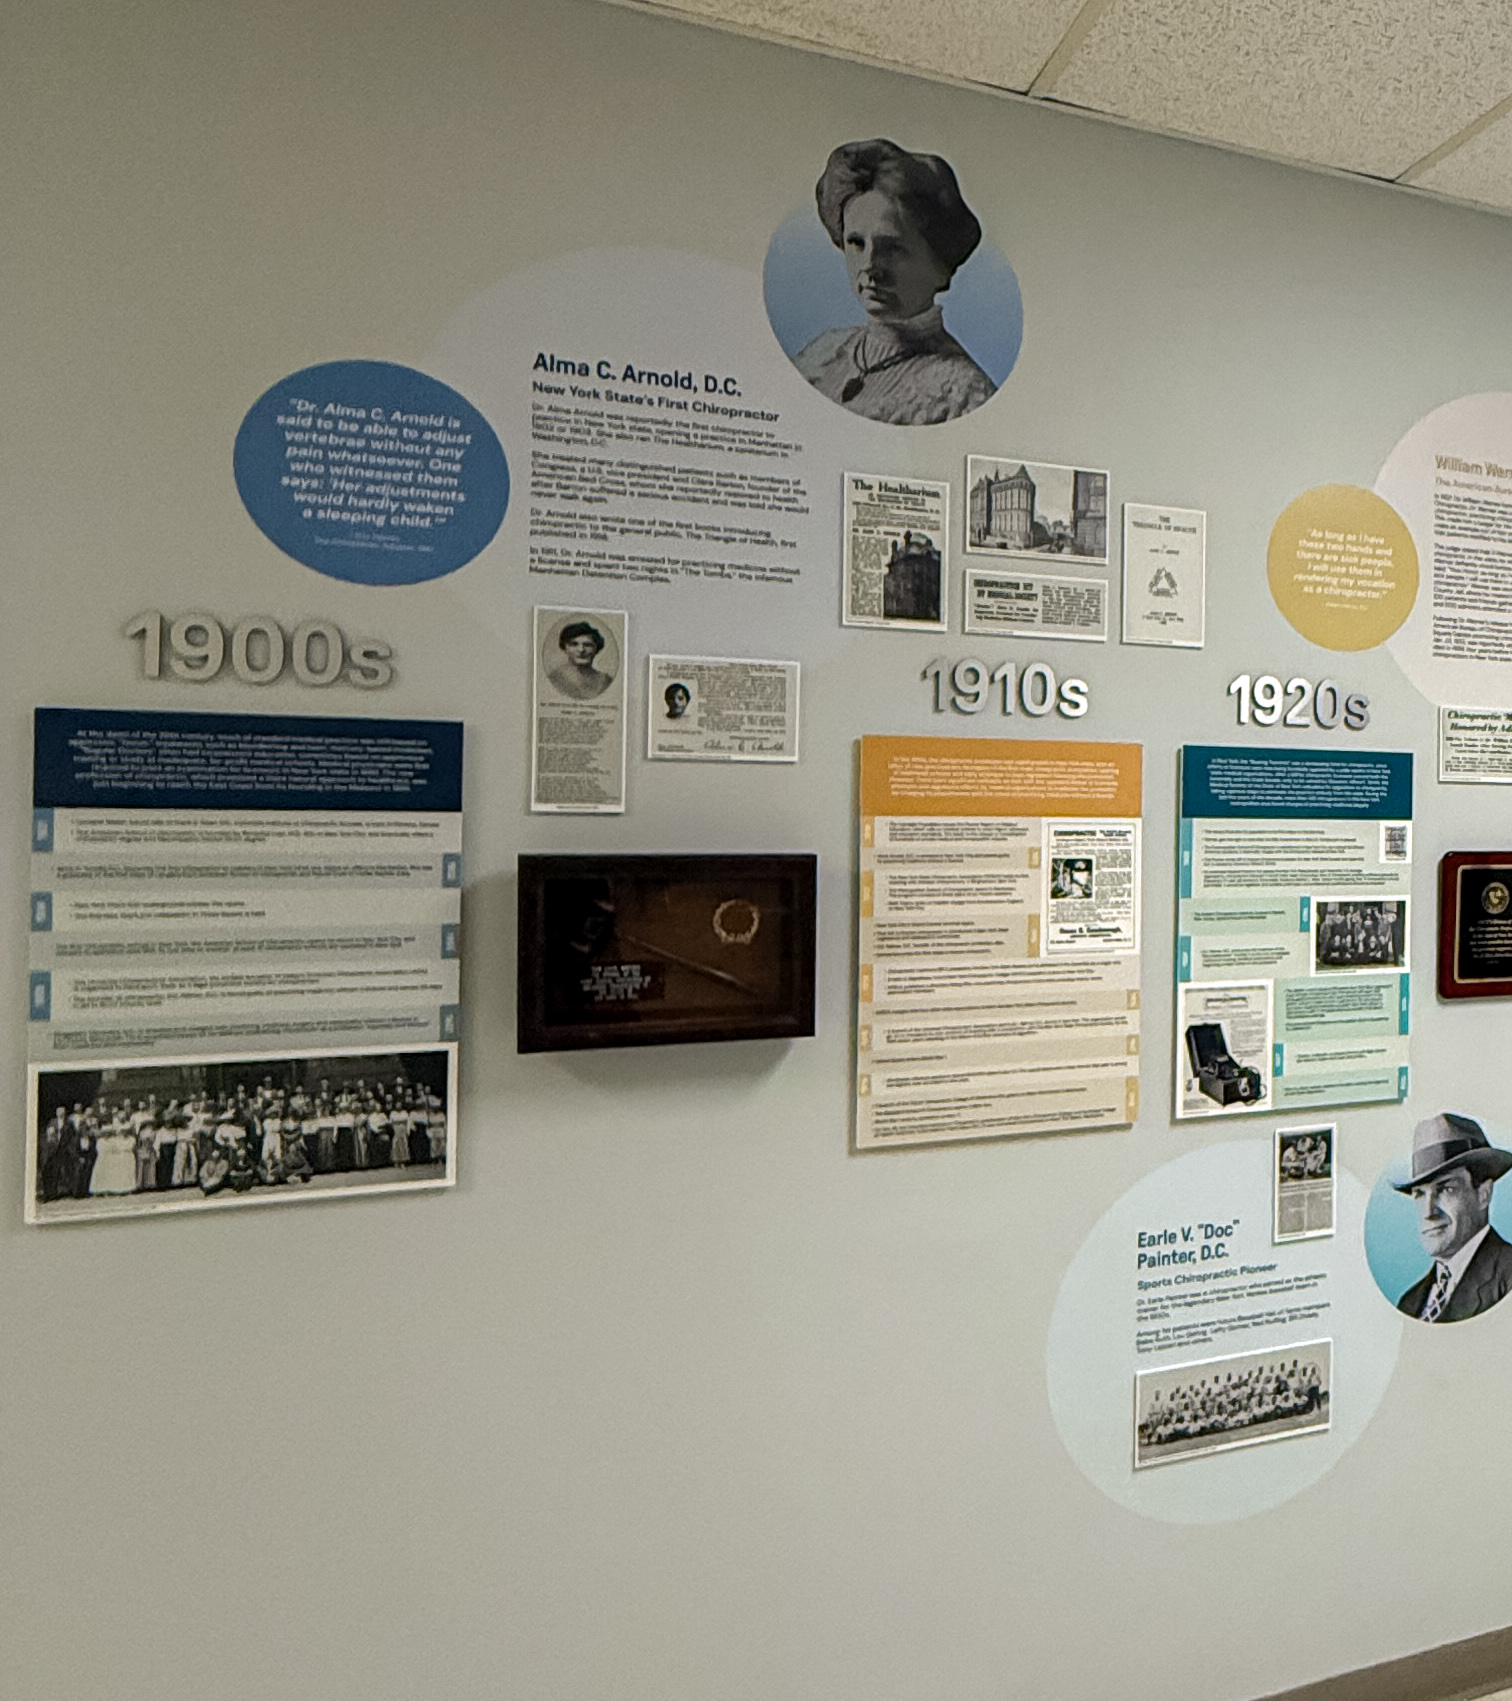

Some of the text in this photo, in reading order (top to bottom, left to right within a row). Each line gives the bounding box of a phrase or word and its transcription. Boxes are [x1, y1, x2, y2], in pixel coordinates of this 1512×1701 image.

[533, 353, 742, 397] Alma C. Arnold, D.C.
[324, 402, 366, 419] Alma
[391, 411, 444, 427] Arnold
[448, 416, 460, 428] is
[533, 381, 780, 422] New York State's First Chiropractor
[277, 415, 472, 445] said to be able to adjust
[285, 431, 464, 460] vertebrae without any
[286, 446, 323, 459] pain
[429, 458, 461, 473] One
[291, 461, 458, 487] who witnessed them
[852, 479, 873, 490] The
[294, 491, 454, 516] would hardly waken
[366, 483, 465, 502] adjustments
[303, 508, 312, 519] a
[317, 507, 385, 528] sleeping
[120, 610, 394, 690] 1900s
[922, 658, 1089, 718] 1910s
[1228, 674, 1370, 729] 1920s
[1138, 1219, 1240, 1248] Earle V. "Doc"
[1138, 1243, 1229, 1269] Painter, D.C.
[1138, 1263, 1278, 1291] Sports Chiropractic Pioneer
